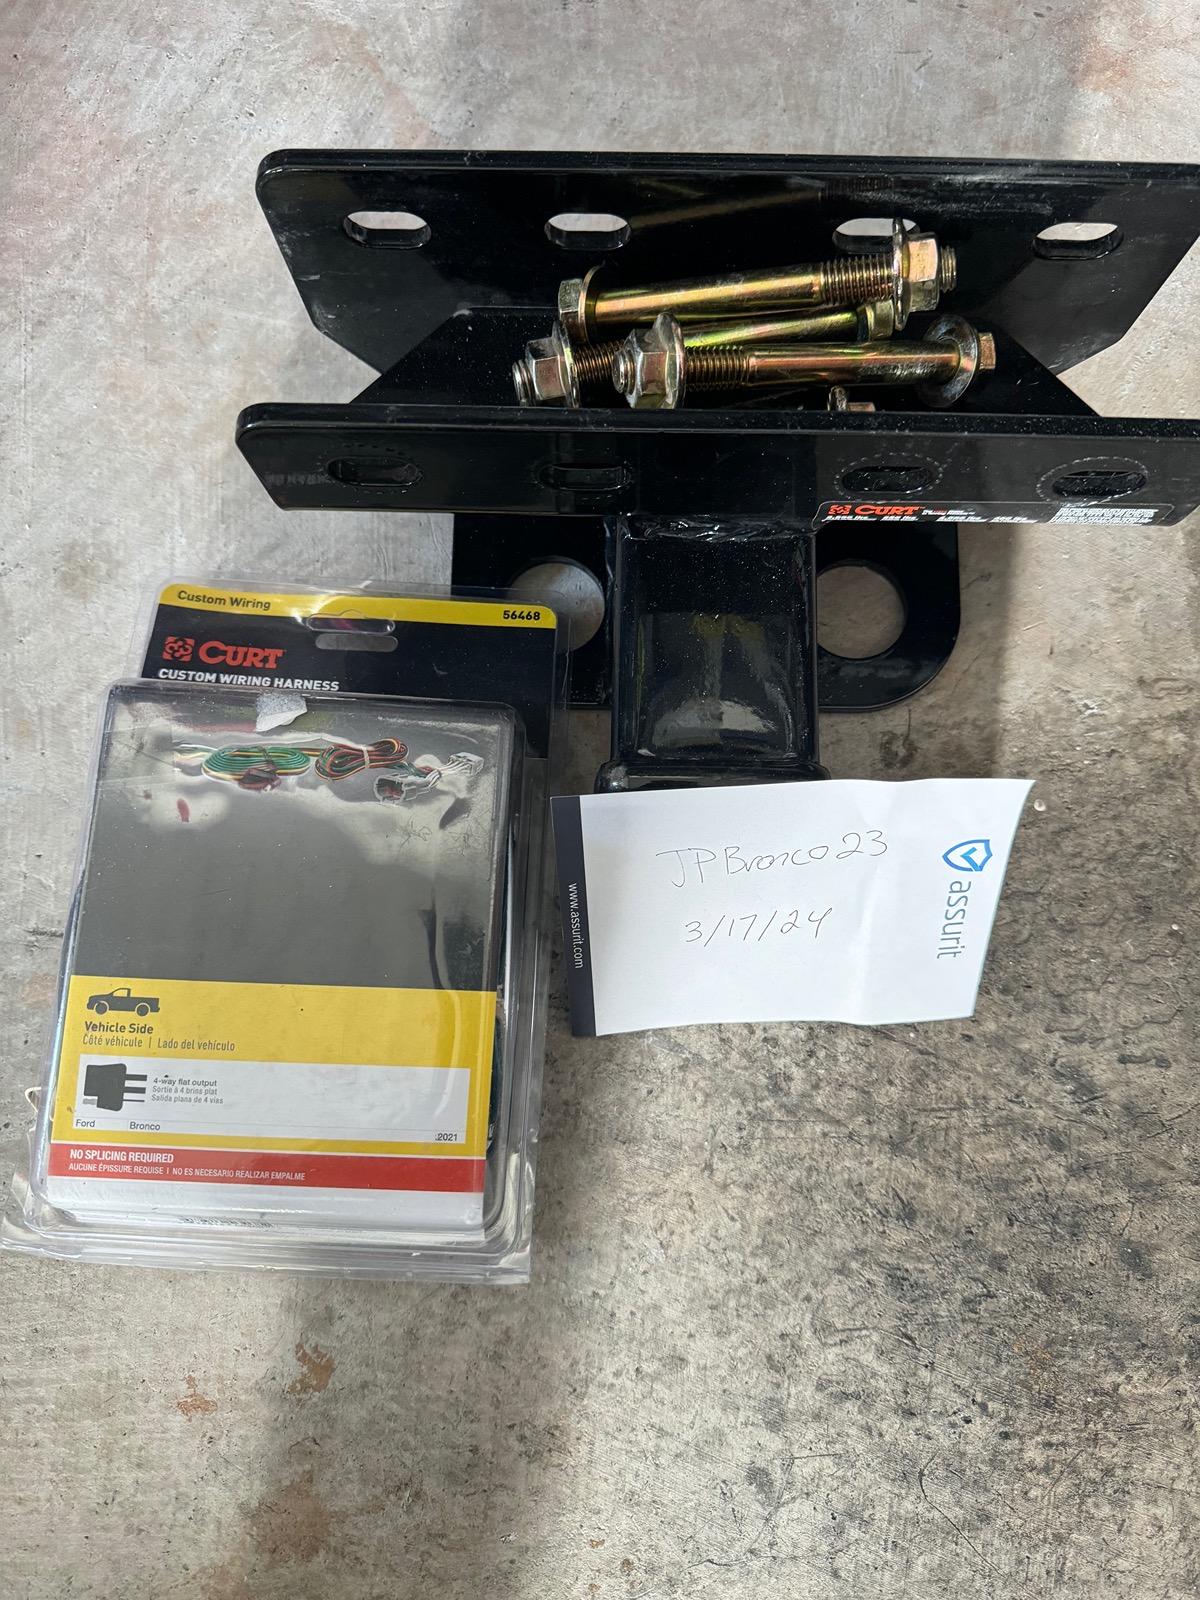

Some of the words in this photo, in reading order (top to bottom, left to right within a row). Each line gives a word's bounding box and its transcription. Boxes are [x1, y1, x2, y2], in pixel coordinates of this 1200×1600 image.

[855, 504, 918, 516] CURT
[177, 590, 226, 605] Custom
[230, 597, 271, 611] Wiring
[503, 609, 541, 621] 56468
[199, 640, 285, 669] CURT
[158, 668, 216, 683] CUSTOM
[220, 674, 271, 687] WIRING
[273, 677, 339, 692] HARNESS
[568, 882, 584, 970] www.assurit.com
[685, 907, 833, 947] 3/17/24
[937, 880, 972, 960] assurit
[84, 1021, 126, 1033] Vehicle
[128, 1023, 154, 1034] Side
[82, 1034, 103, 1046] Côté
[105, 1035, 143, 1047] véhicule
[157, 1038, 178, 1049] Lado
[181, 1039, 195, 1050] del
[153, 1078, 177, 1086] 4-way
[75, 1119, 96, 1128] Ford
[129, 1121, 161, 1131] Bronco
[70, 1149, 83, 1160] NO
[85, 1151, 127, 1161] SPLICING
[128, 1153, 174, 1163] REQUIRED
[68, 1163, 97, 1172] AUCUNE
[98, 1163, 133, 1174] ÉPISSURE
[133, 1166, 164, 1175] REQUISE
[172, 1167, 183, 1176] NO
[184, 1168, 194, 1177] ES
[194, 1169, 235, 1179] NECESARIO
[235, 1171, 270, 1180] REALIZAR
[271, 1172, 305, 1182] EMPALME
